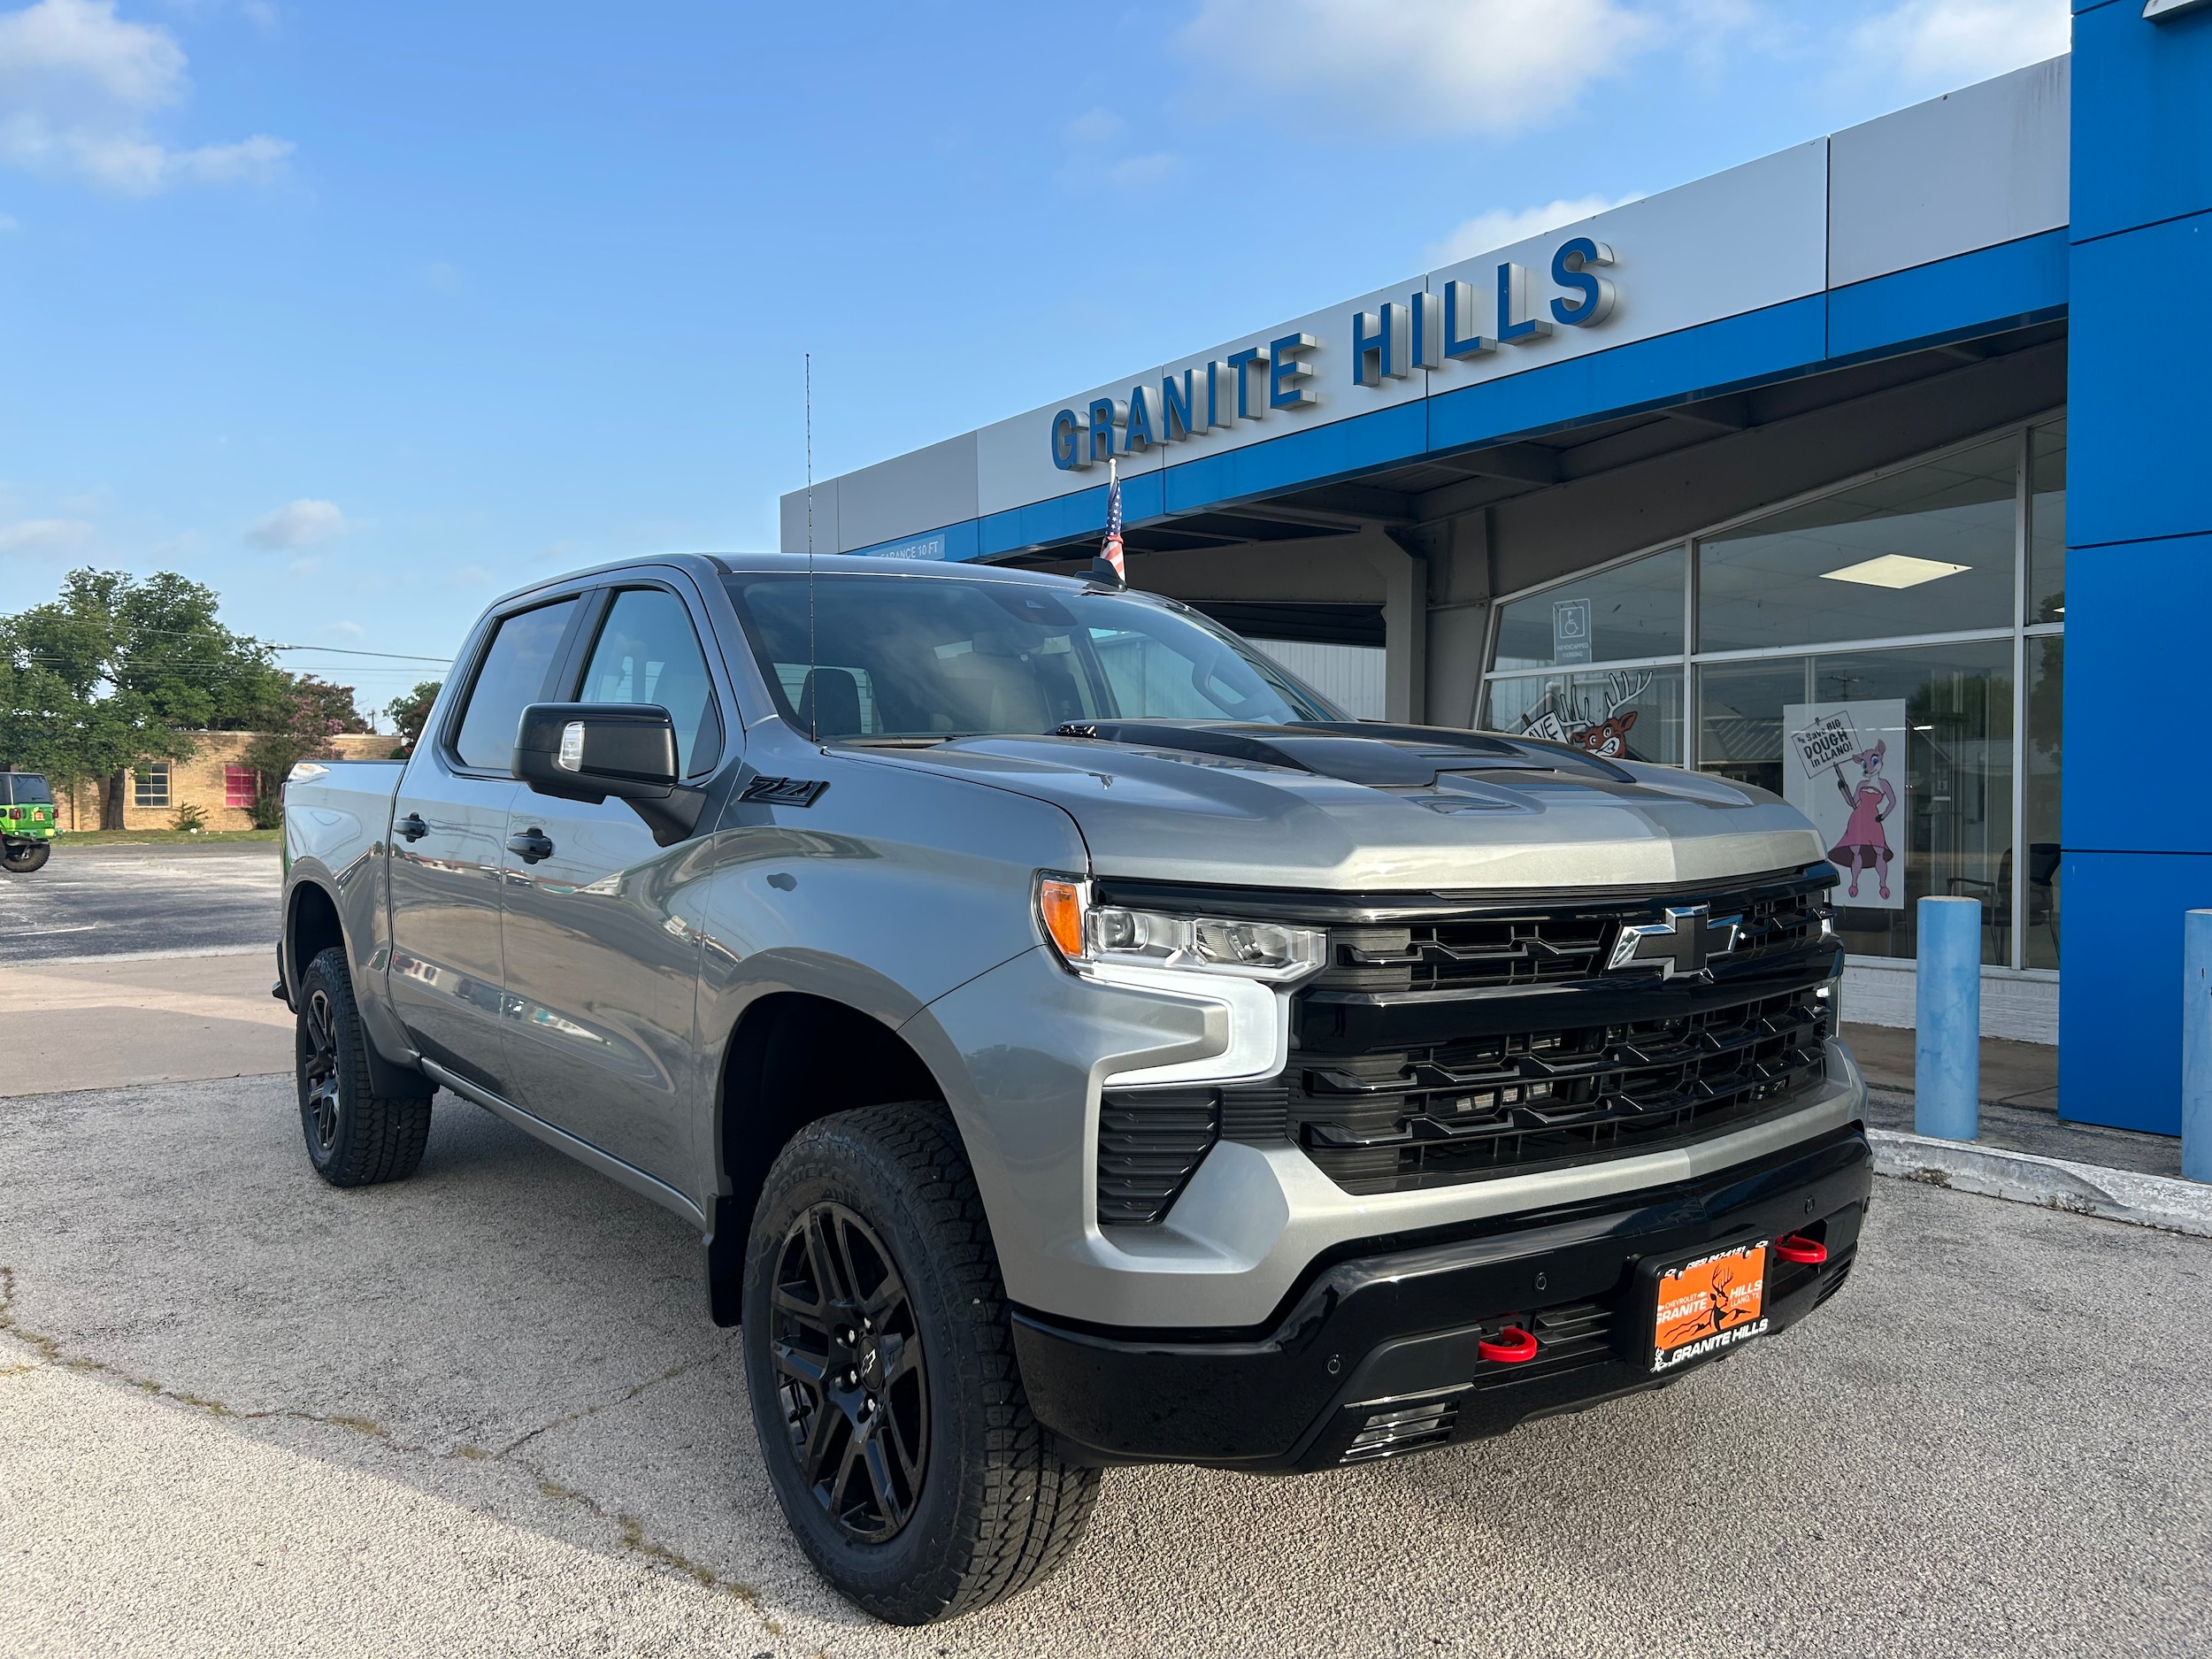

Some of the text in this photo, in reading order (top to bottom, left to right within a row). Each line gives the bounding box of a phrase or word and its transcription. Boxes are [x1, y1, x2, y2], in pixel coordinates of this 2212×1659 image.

[1051, 237, 1616, 472] GRANITE HILLS
[918, 544, 927, 557] 10
[929, 541, 939, 554] FT
[1805, 718, 1841, 741] Save BIG
[1803, 728, 1848, 759] DOUGH
[1820, 741, 1854, 763] LLANO!
[1729, 1279, 1763, 1300] HILLS
[1730, 1291, 1760, 1308] LLANO, TX
[1656, 1298, 1708, 1325] GRANITE
[1665, 1293, 1697, 1310] CHEVROLET
[1672, 1317, 1769, 1363] GRANITE HILLS
